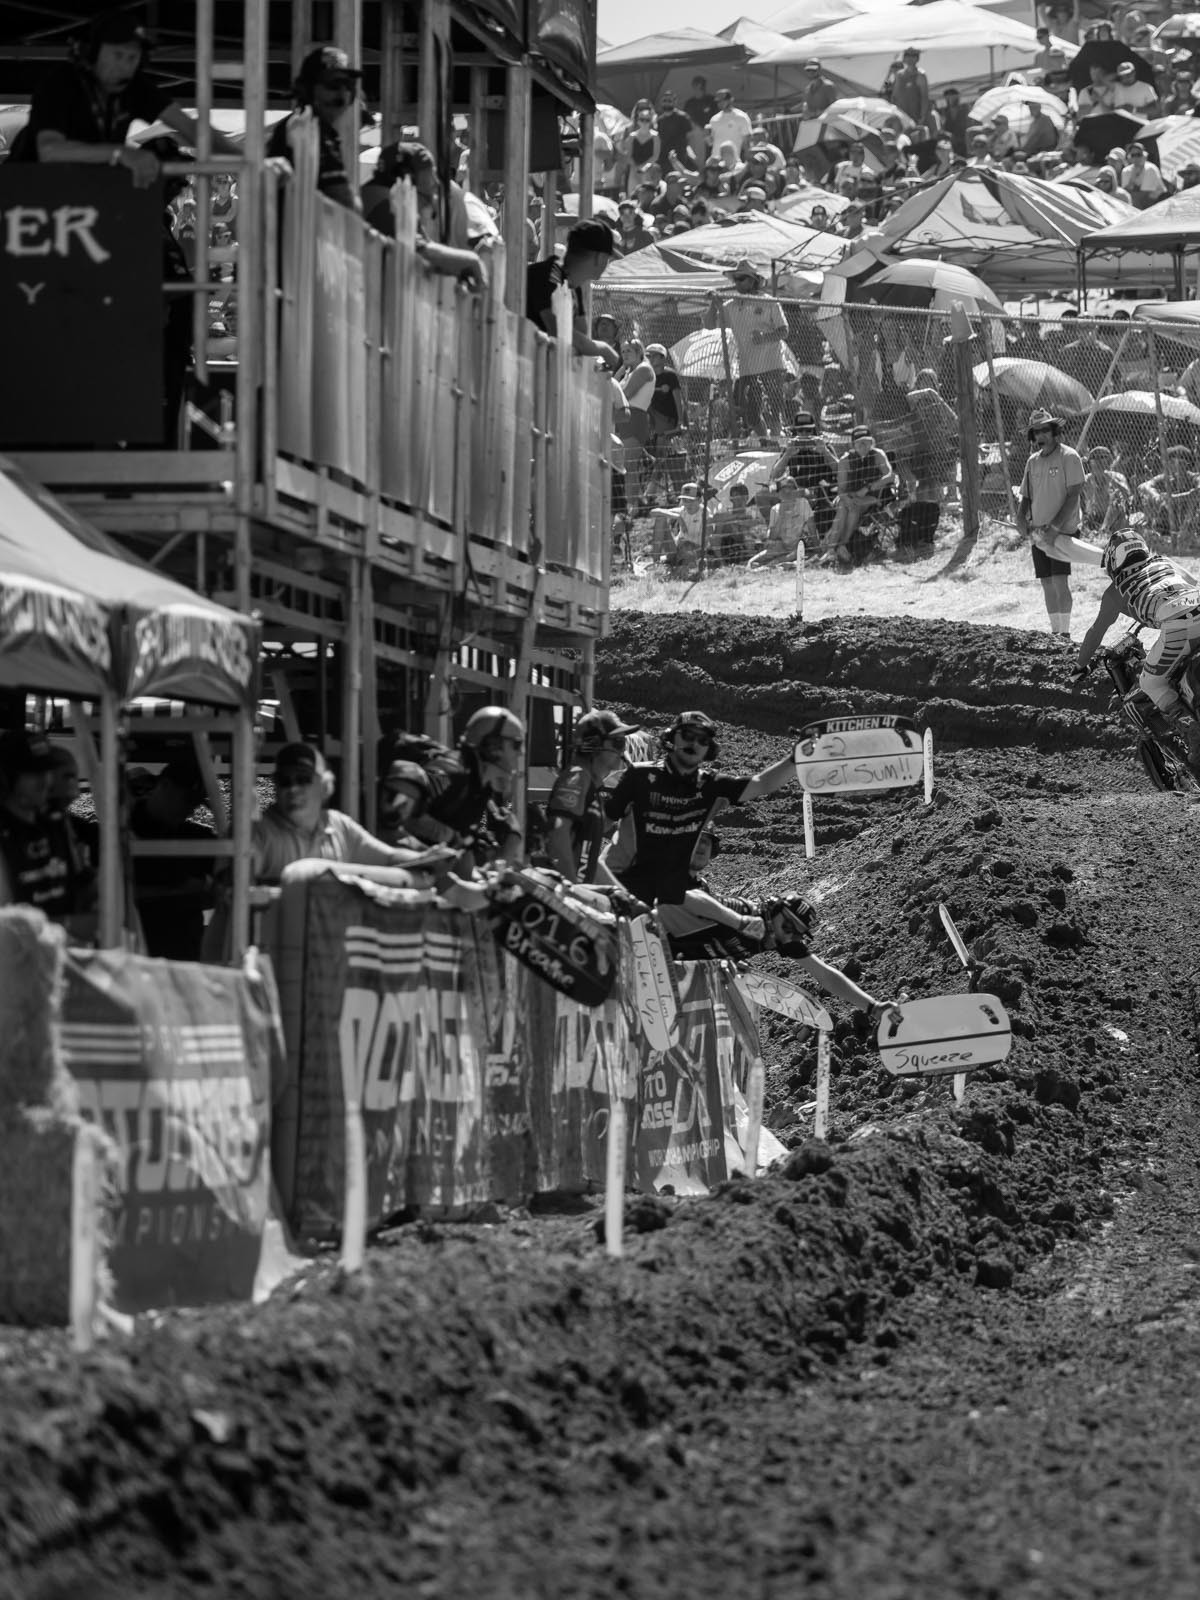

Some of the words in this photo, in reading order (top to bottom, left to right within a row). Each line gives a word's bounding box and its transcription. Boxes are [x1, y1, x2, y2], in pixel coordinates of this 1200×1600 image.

[826, 717, 880, 733] KITCHEN
[882, 715, 898, 728] 47
[645, 821, 703, 835] Kawsak
[894, 1048, 974, 1072] Squeeze
